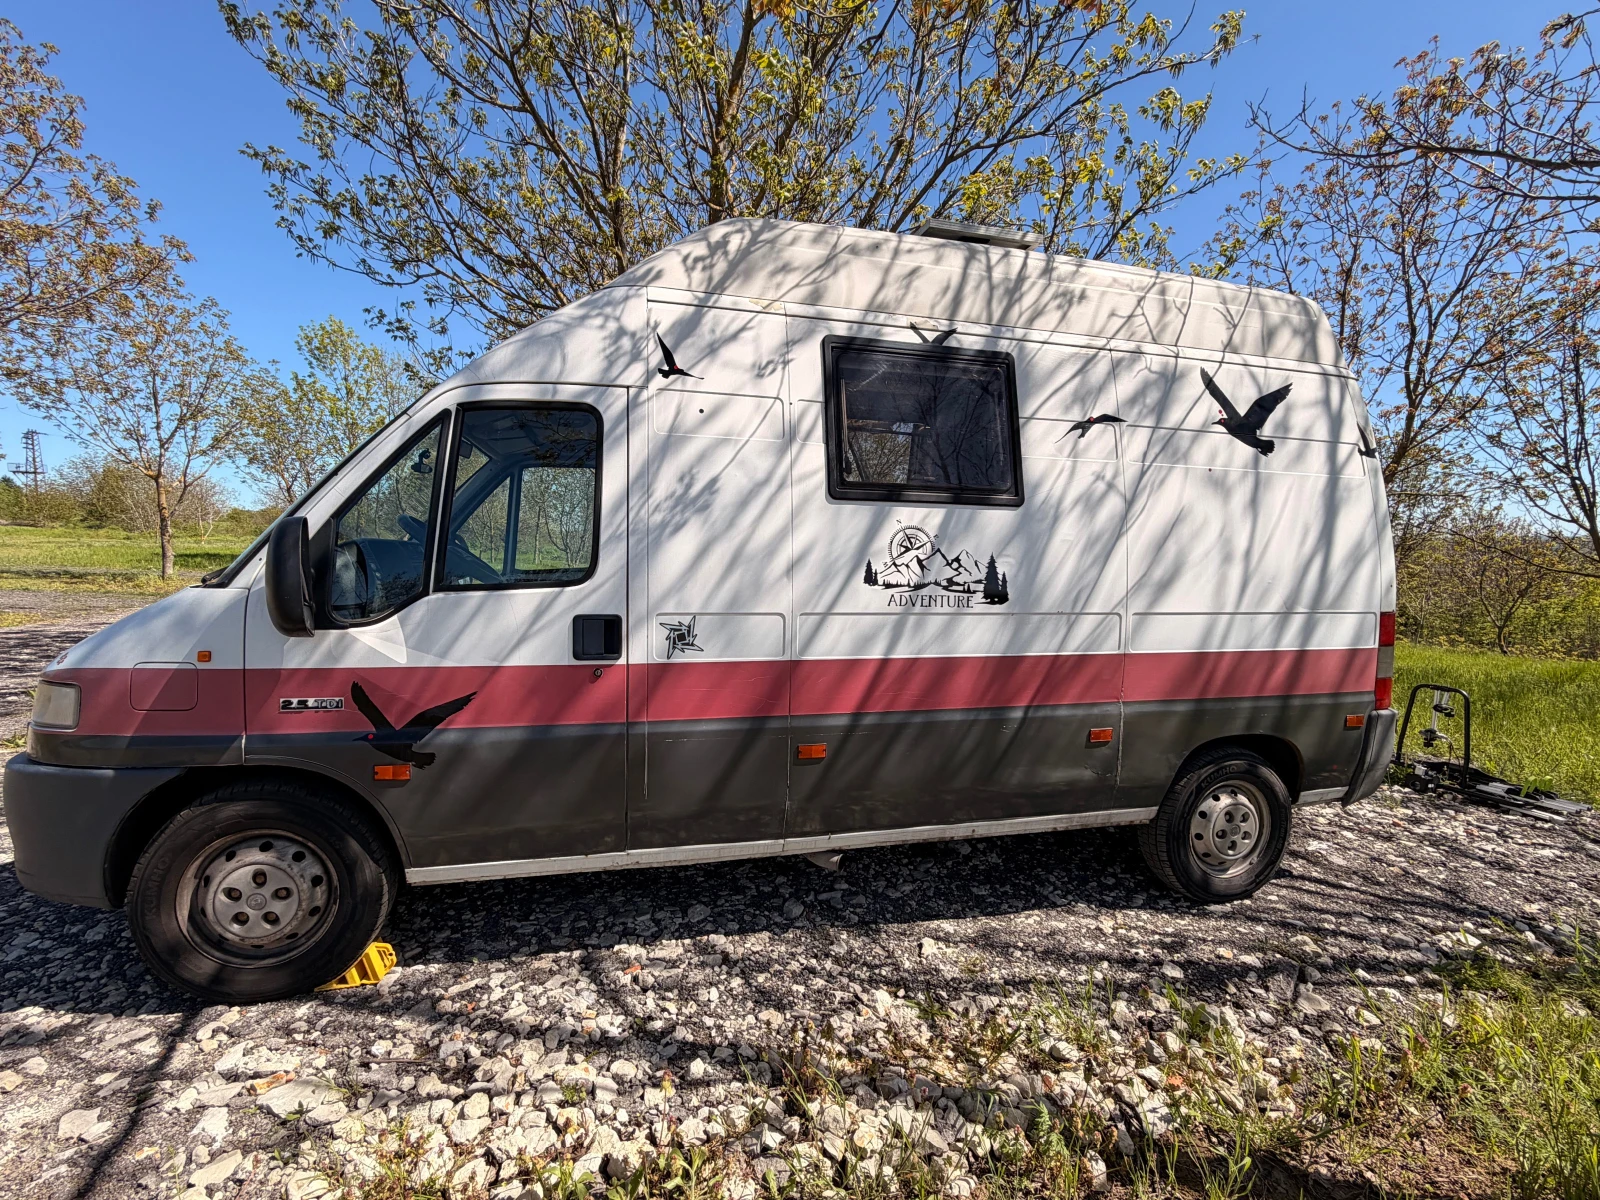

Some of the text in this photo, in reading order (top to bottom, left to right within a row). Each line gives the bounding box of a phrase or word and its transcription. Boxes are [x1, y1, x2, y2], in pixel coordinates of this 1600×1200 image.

[887, 594, 974, 609] ADVENTURE
[313, 698, 344, 710] TDI
[1201, 765, 1237, 788] KUMHO
[144, 855, 170, 920] KUMHO
